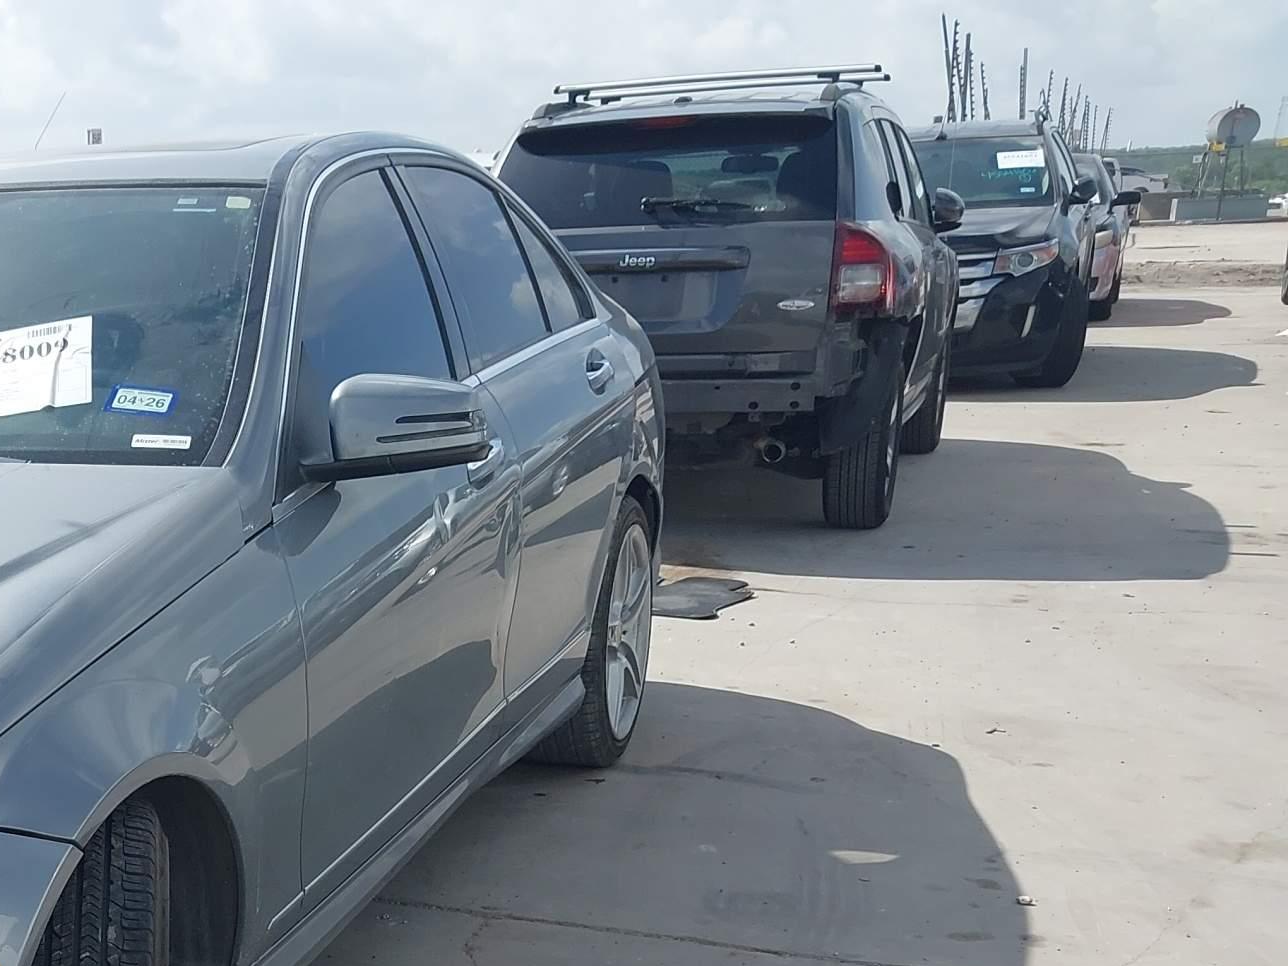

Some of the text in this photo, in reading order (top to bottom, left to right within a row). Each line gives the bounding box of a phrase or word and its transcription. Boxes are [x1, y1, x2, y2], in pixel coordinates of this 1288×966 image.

[619, 254, 655, 268] Jeep
[117, 394, 137, 406] 04
[144, 397, 166, 408] 26
